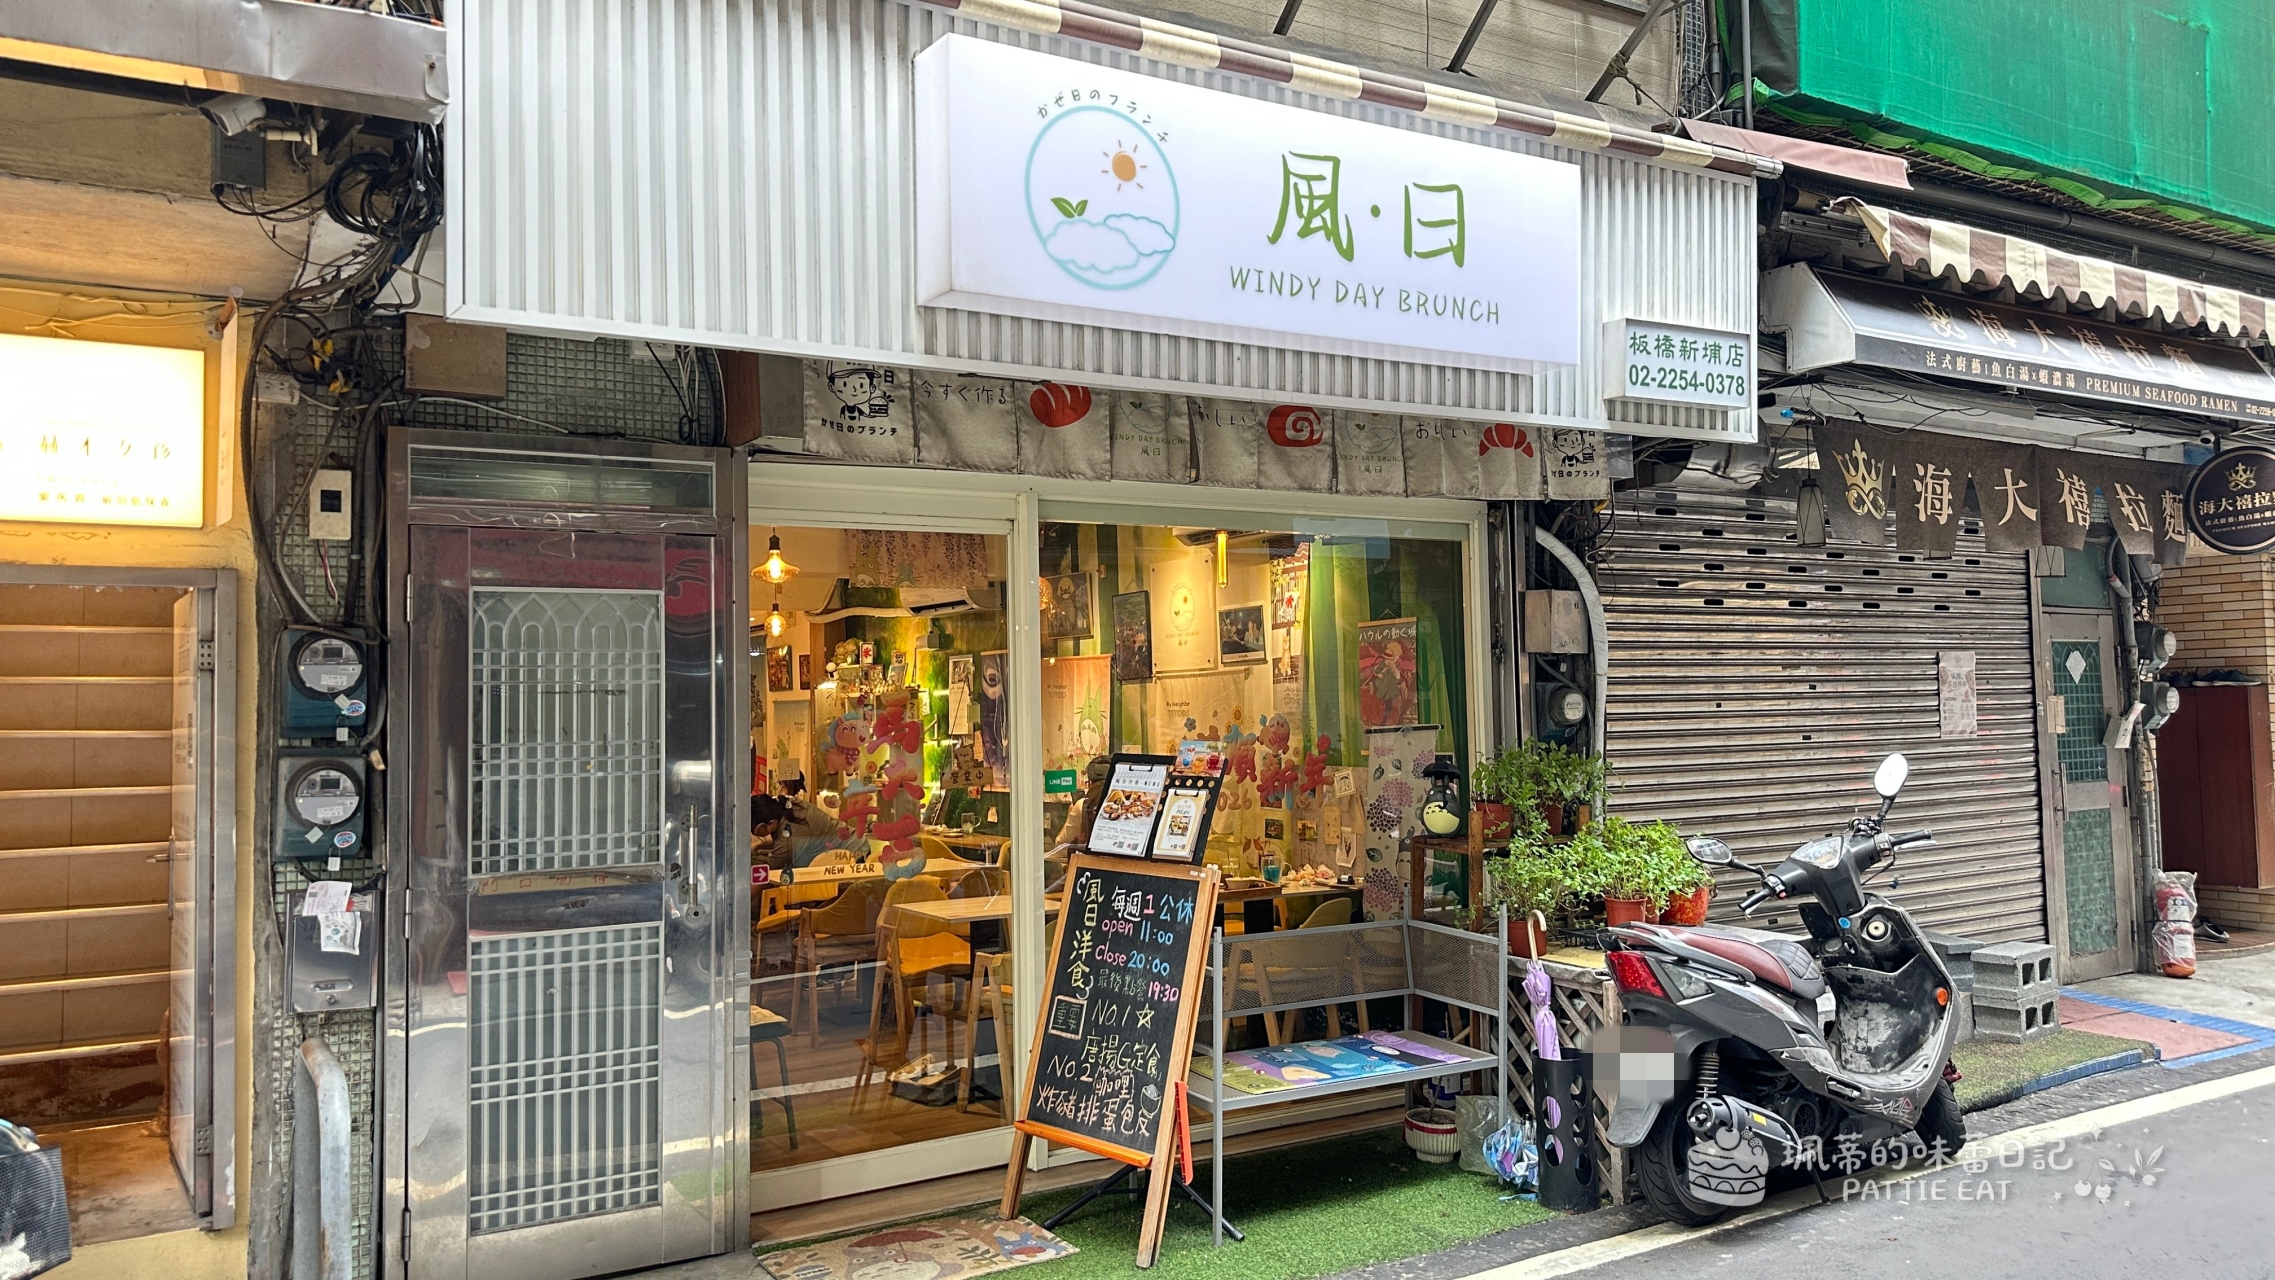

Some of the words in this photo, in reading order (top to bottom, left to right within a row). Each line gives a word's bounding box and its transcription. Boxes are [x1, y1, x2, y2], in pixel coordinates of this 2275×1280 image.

[1230, 265, 1321, 301] WINDY
[1336, 280, 1384, 309] DAY
[1399, 288, 1499, 324] BRUNCH
[1629, 331, 1745, 367] 板橋新埔店
[921, 380, 1006, 405] 今すぐ作る
[1629, 364, 1745, 396] 02-2254-0378
[2086, 377, 2140, 398] PREMIUM
[2145, 386, 2197, 406] SEAFOOD
[2201, 395, 2238, 412] RAMEN
[1913, 462, 2187, 543] 海大禧拉麵
[824, 867, 845, 877] NEW
[850, 864, 875, 875] YEAR
[1067, 879, 1105, 989] 風日洋食
[1101, 919, 1134, 940] open
[1140, 920, 1174, 946] 11:00
[1127, 950, 1170, 977] 20:00
[1147, 980, 1180, 1002] 19:30
